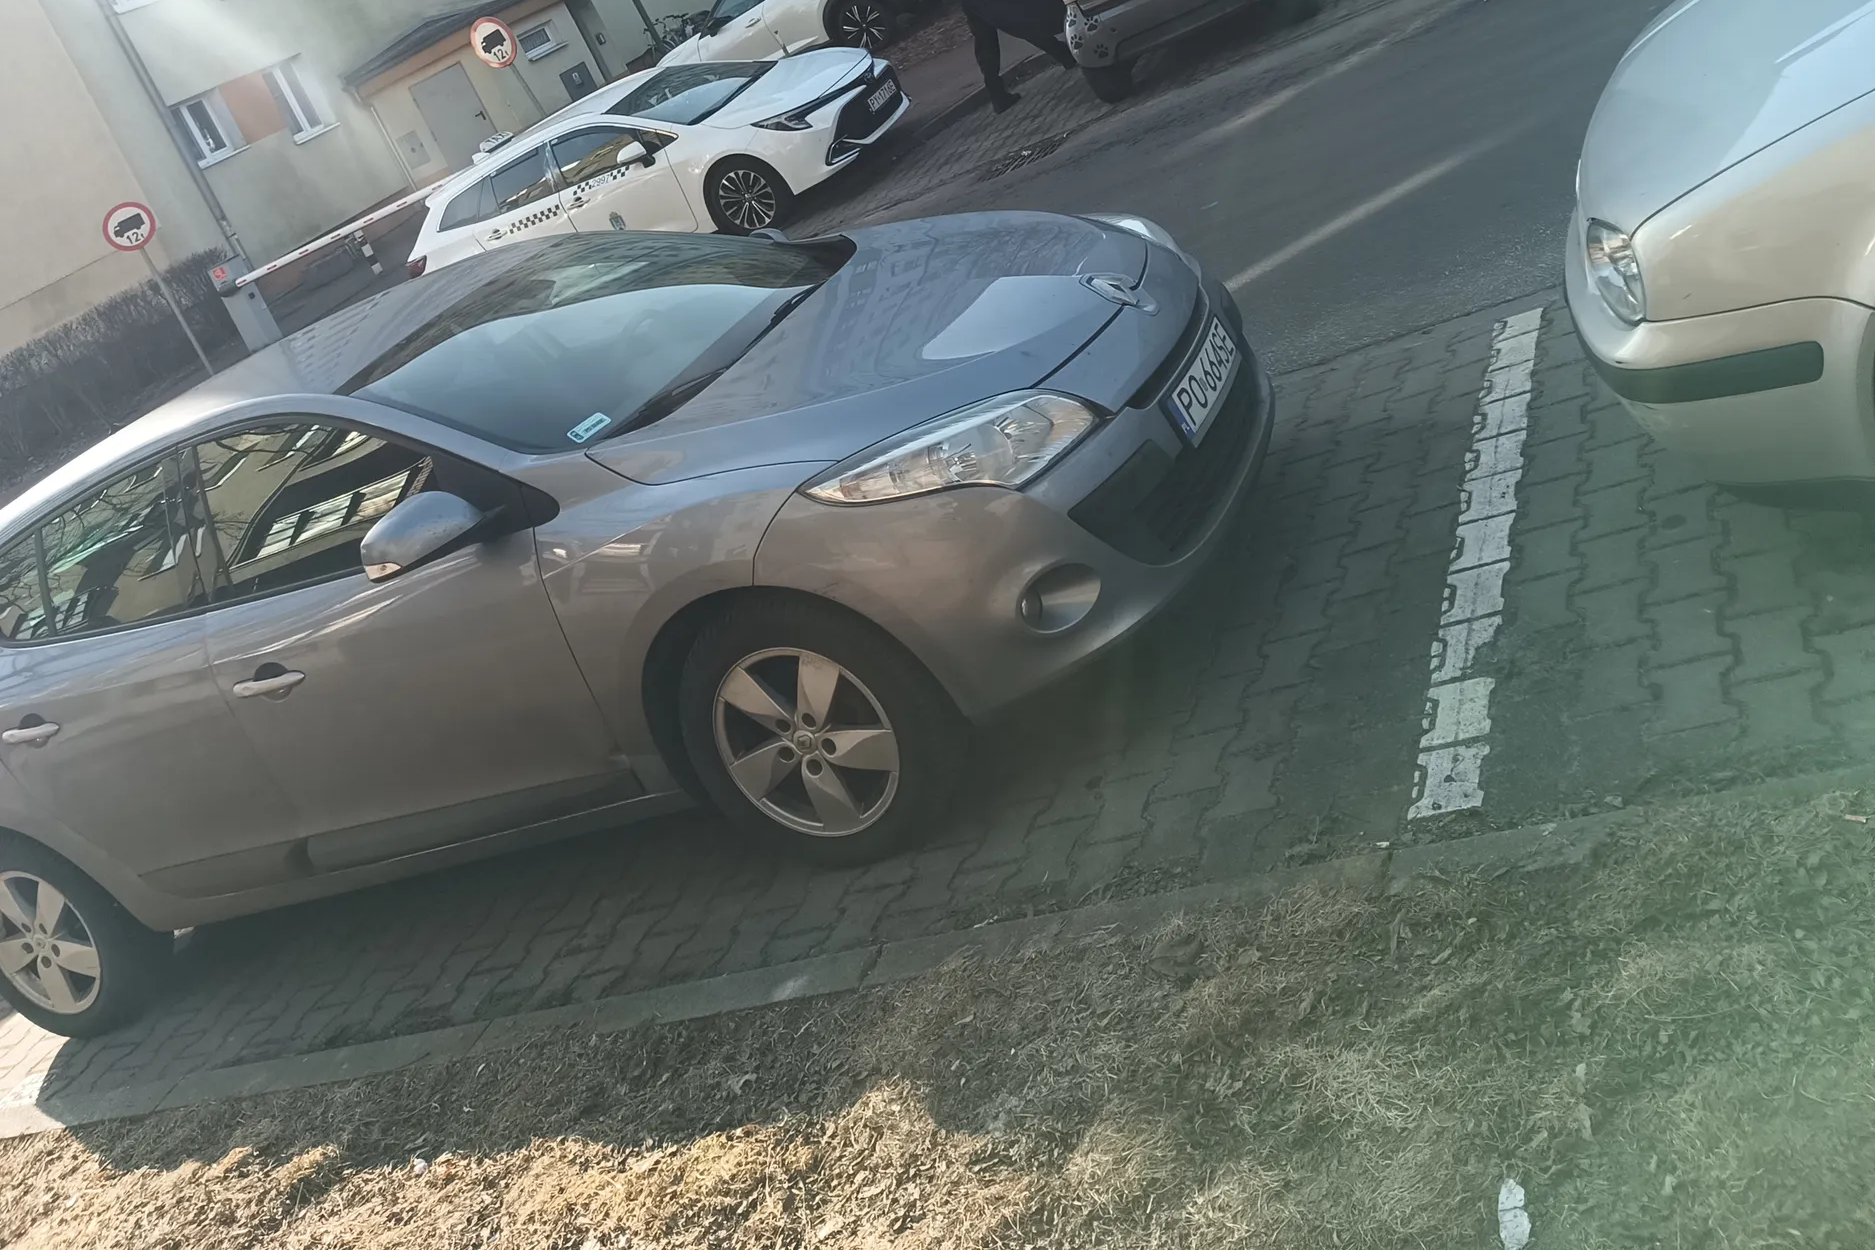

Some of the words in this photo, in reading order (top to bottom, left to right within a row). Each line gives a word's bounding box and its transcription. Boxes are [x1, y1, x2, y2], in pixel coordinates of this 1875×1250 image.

[485, 131, 511, 146] TAXI
[592, 173, 610, 188] 2997
[1177, 374, 1208, 426] PO
[1200, 322, 1235, 392] 664SE
